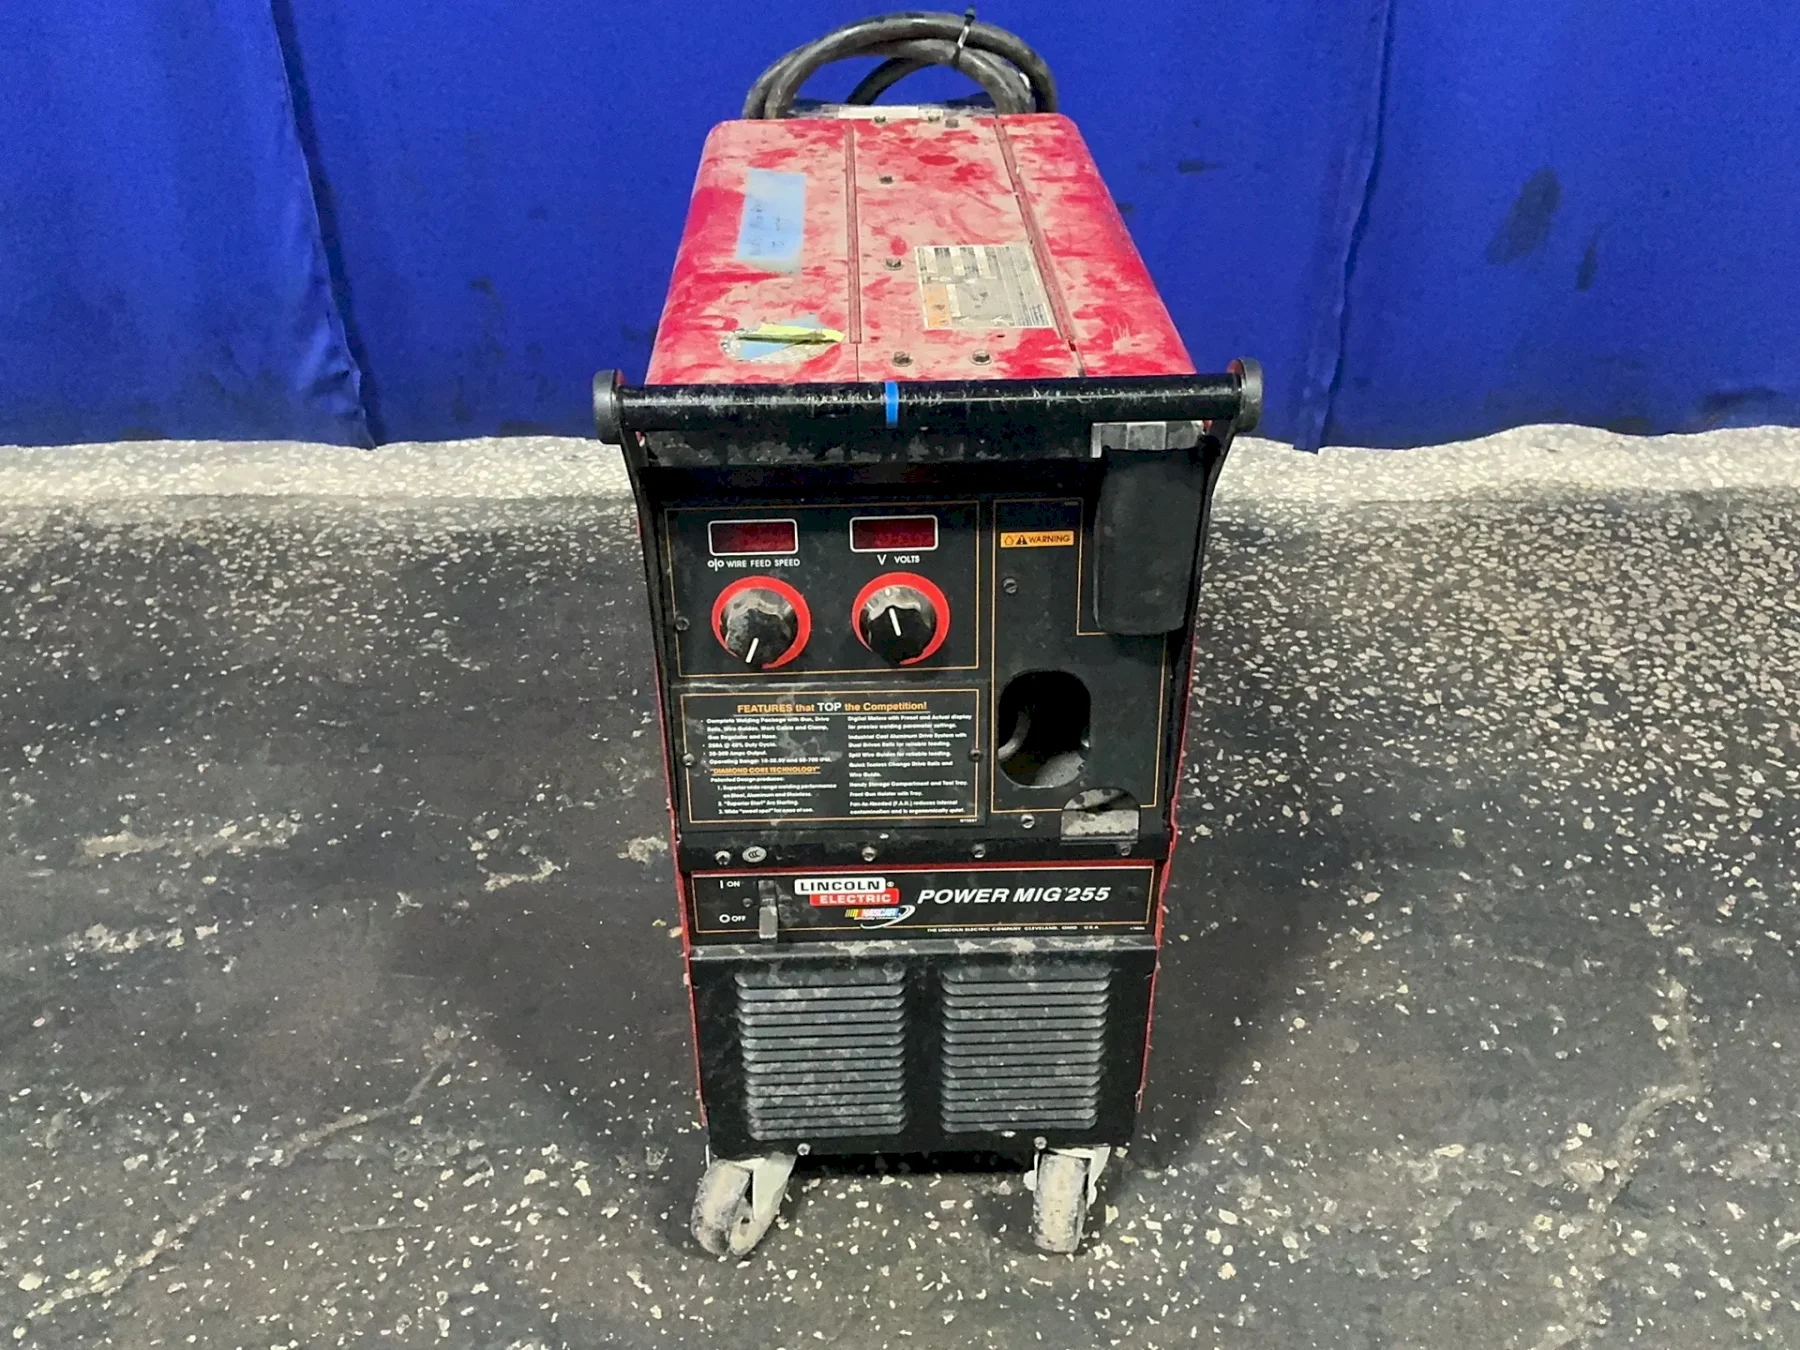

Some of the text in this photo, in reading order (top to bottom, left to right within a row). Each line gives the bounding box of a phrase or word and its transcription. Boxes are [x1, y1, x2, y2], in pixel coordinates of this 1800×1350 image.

[1029, 535, 1070, 543] WARNING
[726, 558, 800, 568] WIRE FEED SPEED
[894, 555, 920, 564] VOLTS
[737, 702, 927, 713] FEATURES that TOP the Competition!
[800, 881, 880, 891] LINCOLN
[820, 894, 891, 904] ELECTRIC
[917, 887, 1111, 904] POWER MIG 255
